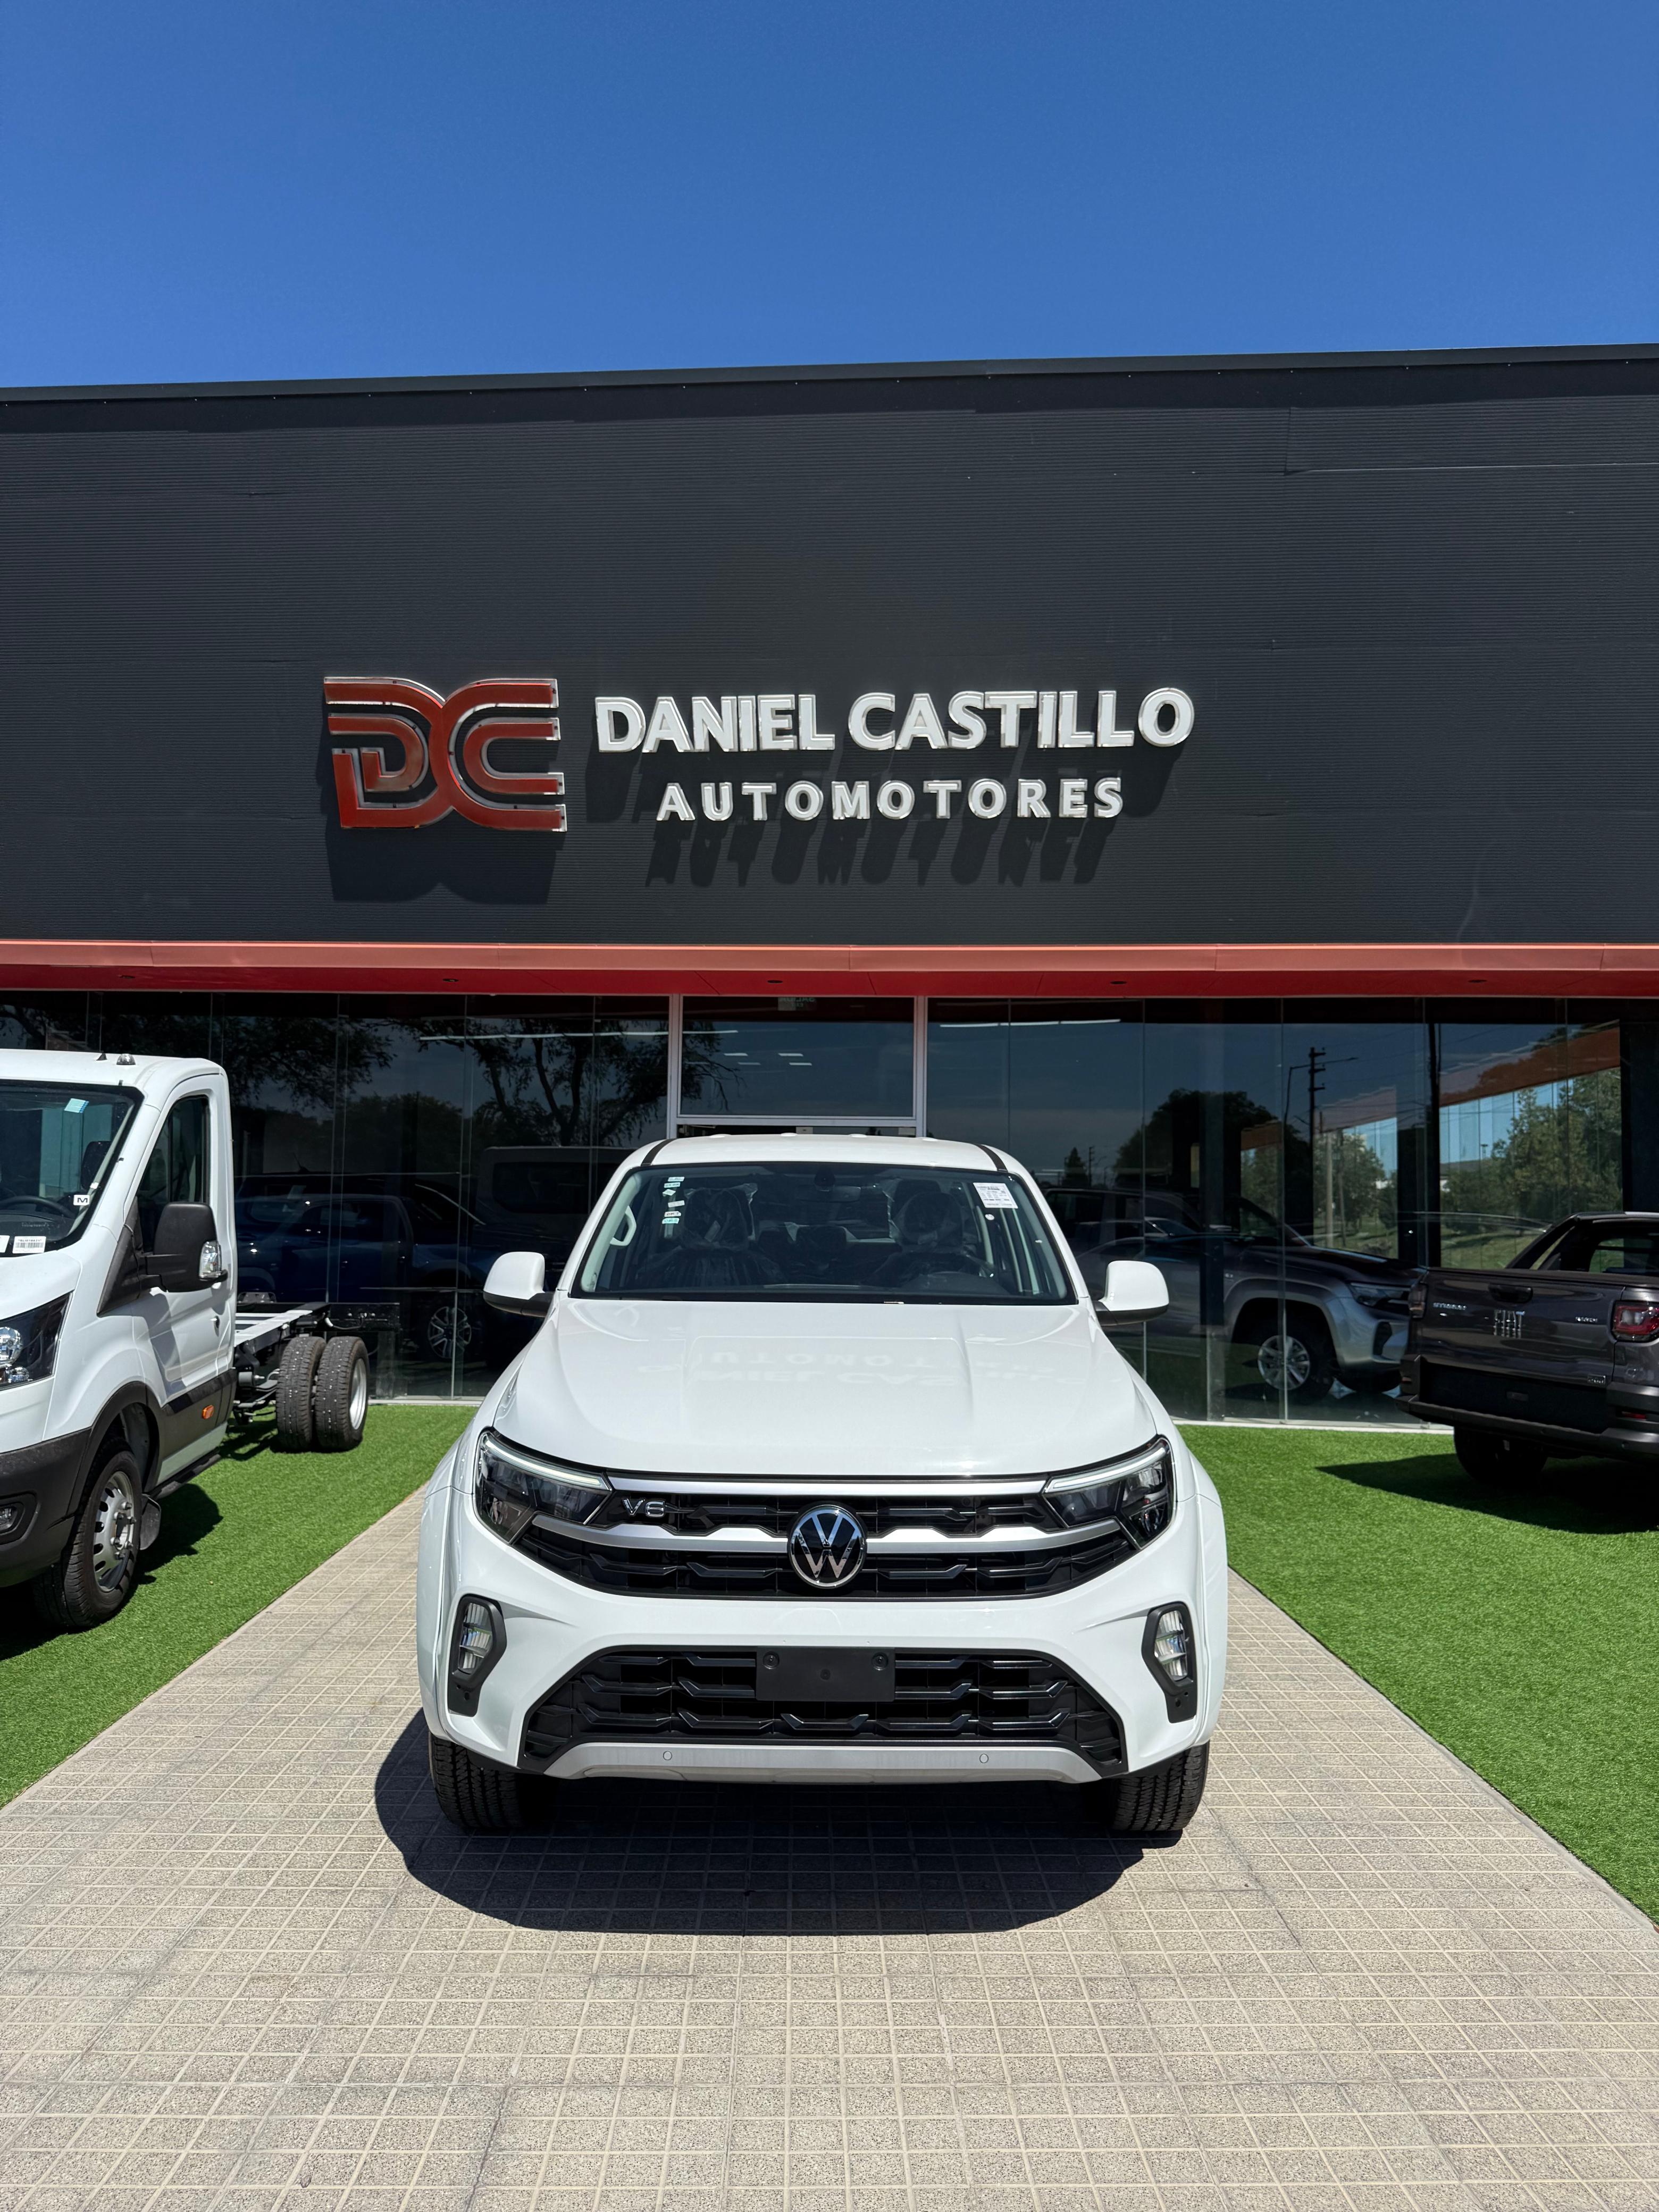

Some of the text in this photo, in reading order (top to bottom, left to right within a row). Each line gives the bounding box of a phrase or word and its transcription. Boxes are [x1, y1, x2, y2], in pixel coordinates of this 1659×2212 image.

[594, 688, 1195, 752] DANIEL CASTILLO
[656, 778, 1123, 821] AUTOMOTORES
[622, 1498, 665, 1518] V6
[791, 1504, 865, 1587] VW
